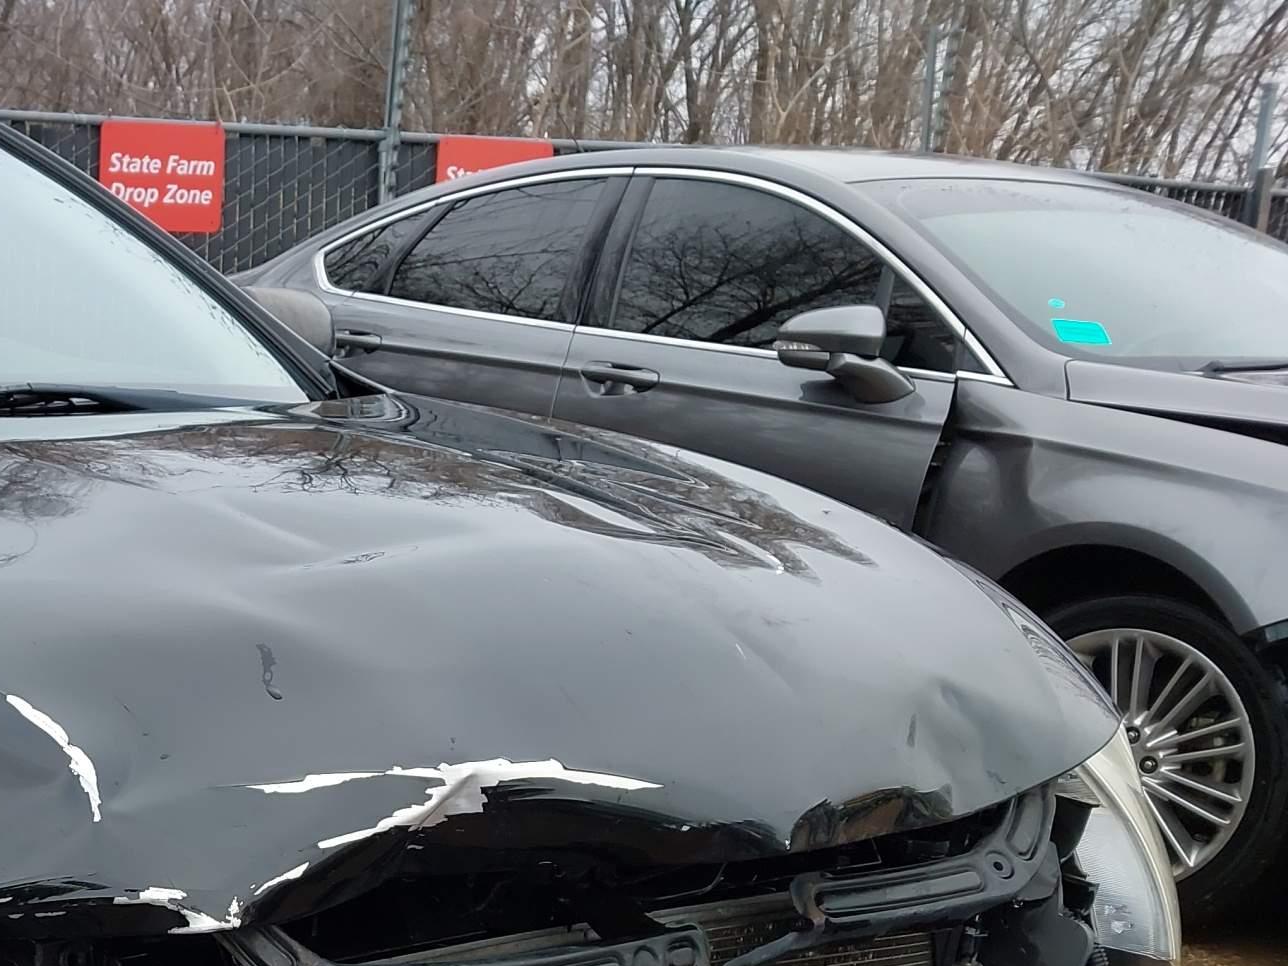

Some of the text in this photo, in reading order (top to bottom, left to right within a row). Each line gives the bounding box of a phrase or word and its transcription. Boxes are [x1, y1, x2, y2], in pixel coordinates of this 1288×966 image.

[108, 152, 215, 176] State Farm
[111, 182, 213, 207] Drop Zone
